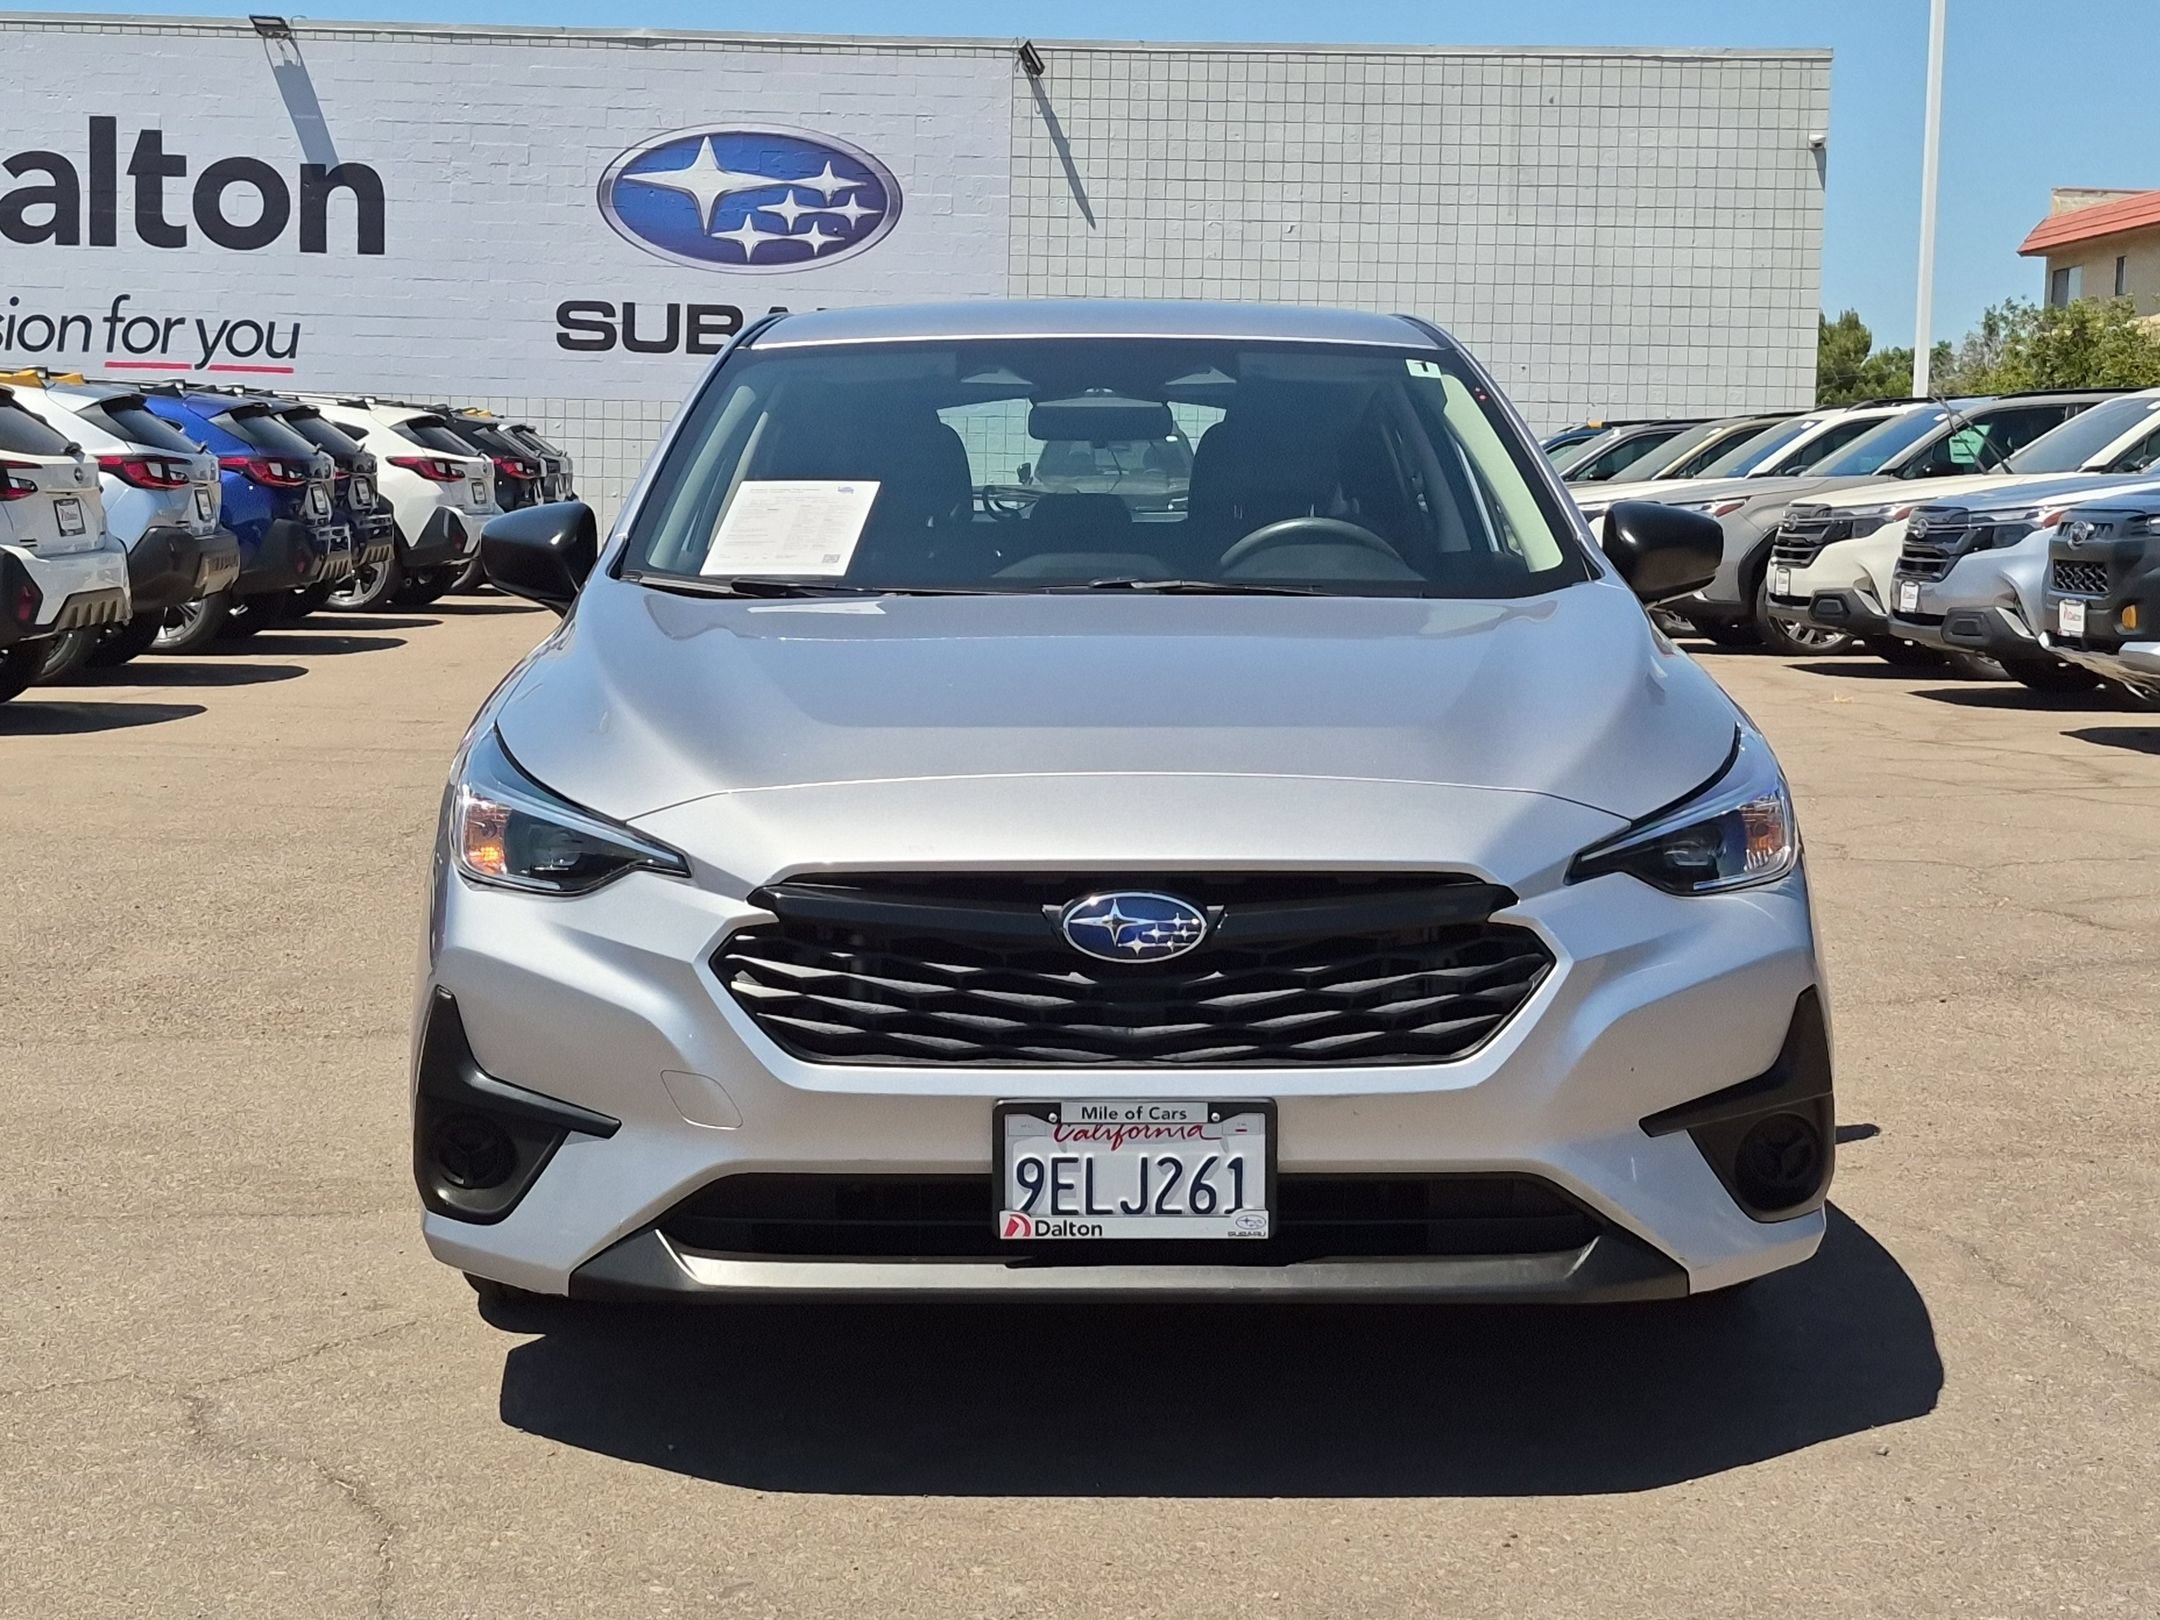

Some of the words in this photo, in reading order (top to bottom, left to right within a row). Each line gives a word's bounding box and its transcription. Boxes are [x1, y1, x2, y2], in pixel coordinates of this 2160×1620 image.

[0, 296, 93, 353] ion
[103, 294, 187, 354] for
[194, 318, 301, 370] you
[556, 300, 800, 355] SUB
[1081, 1106, 1119, 1121] Mile
[1125, 1106, 1143, 1121] of
[1149, 1106, 1187, 1121] Cars
[1053, 1122, 1222, 1151] California
[1016, 1156, 1244, 1216] 9ELJ261
[1035, 1219, 1103, 1237] Dalton
